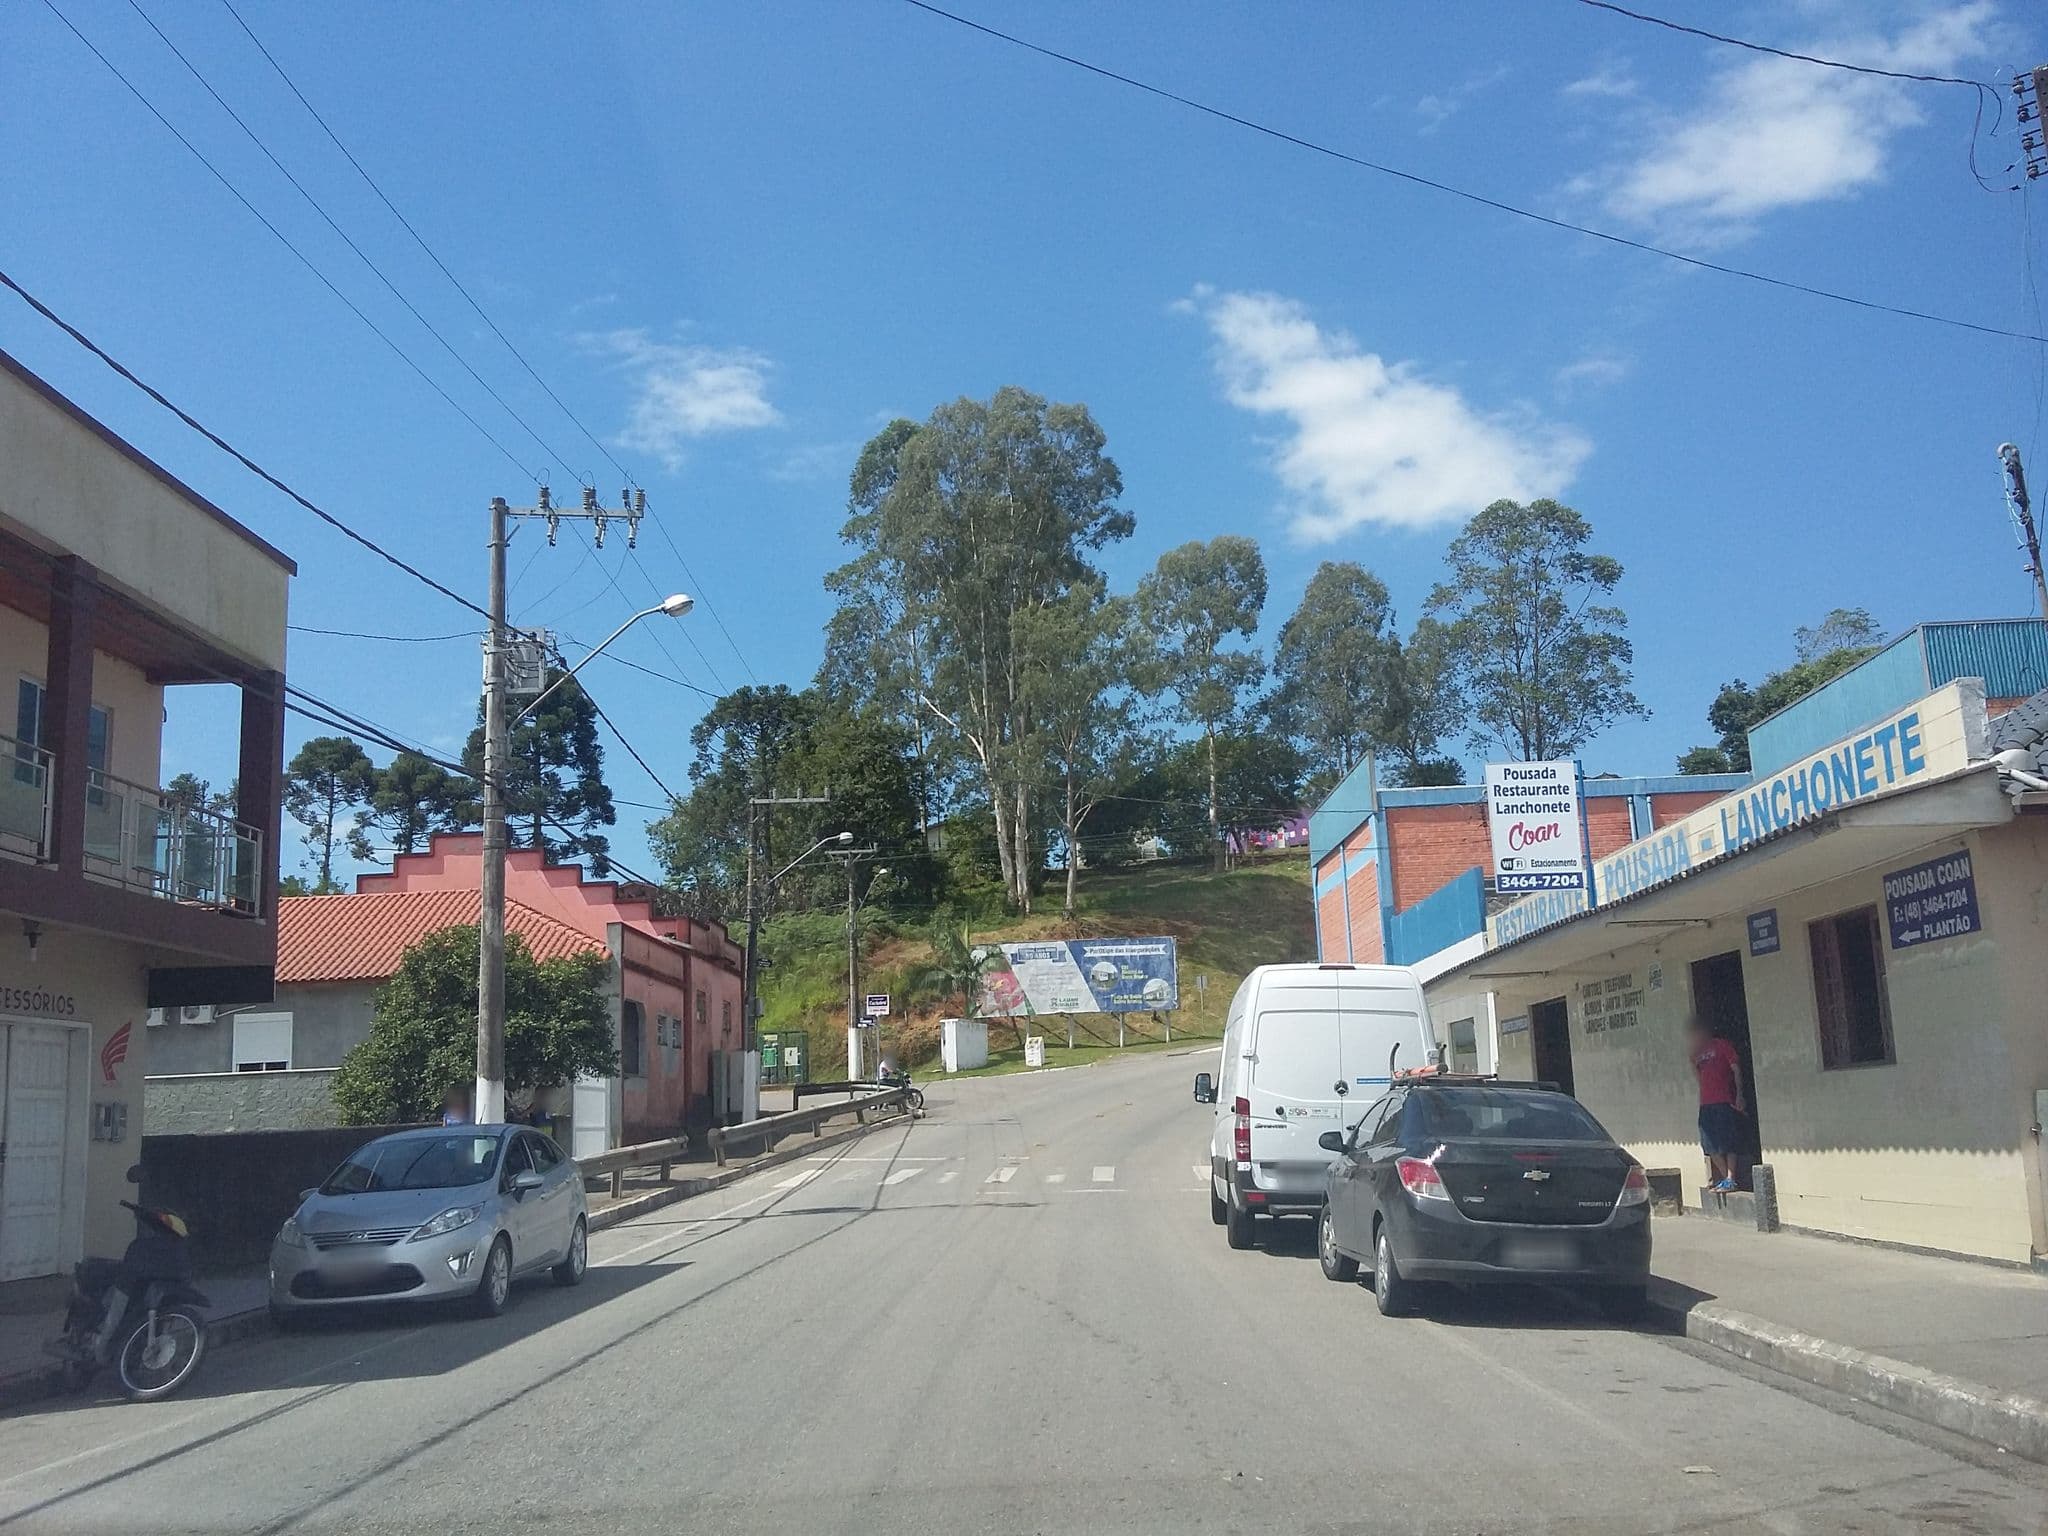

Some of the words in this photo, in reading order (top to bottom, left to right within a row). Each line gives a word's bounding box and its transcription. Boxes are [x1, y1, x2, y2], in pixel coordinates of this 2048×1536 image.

[1503, 767, 1557, 780] Pousada
[1493, 783, 1570, 797] Restaurante
[1495, 801, 1571, 814] Lanchonete
[1496, 889, 1584, 944] RESTAURANTE
[1604, 828, 1691, 903] POUSADA
[1721, 712, 1925, 855] LANCHONETE
[1508, 821, 1562, 851] Coan
[1530, 859, 1577, 868] Estacionamento
[1501, 875, 1579, 888] 3464-7204
[1885, 869, 1936, 900] POUSADA
[1937, 857, 1970, 885] COAN
[1904, 900, 1921, 924] (48)
[1922, 887, 1968, 915] 3464-7204
[1924, 914, 1971, 939] PLANTÃO
